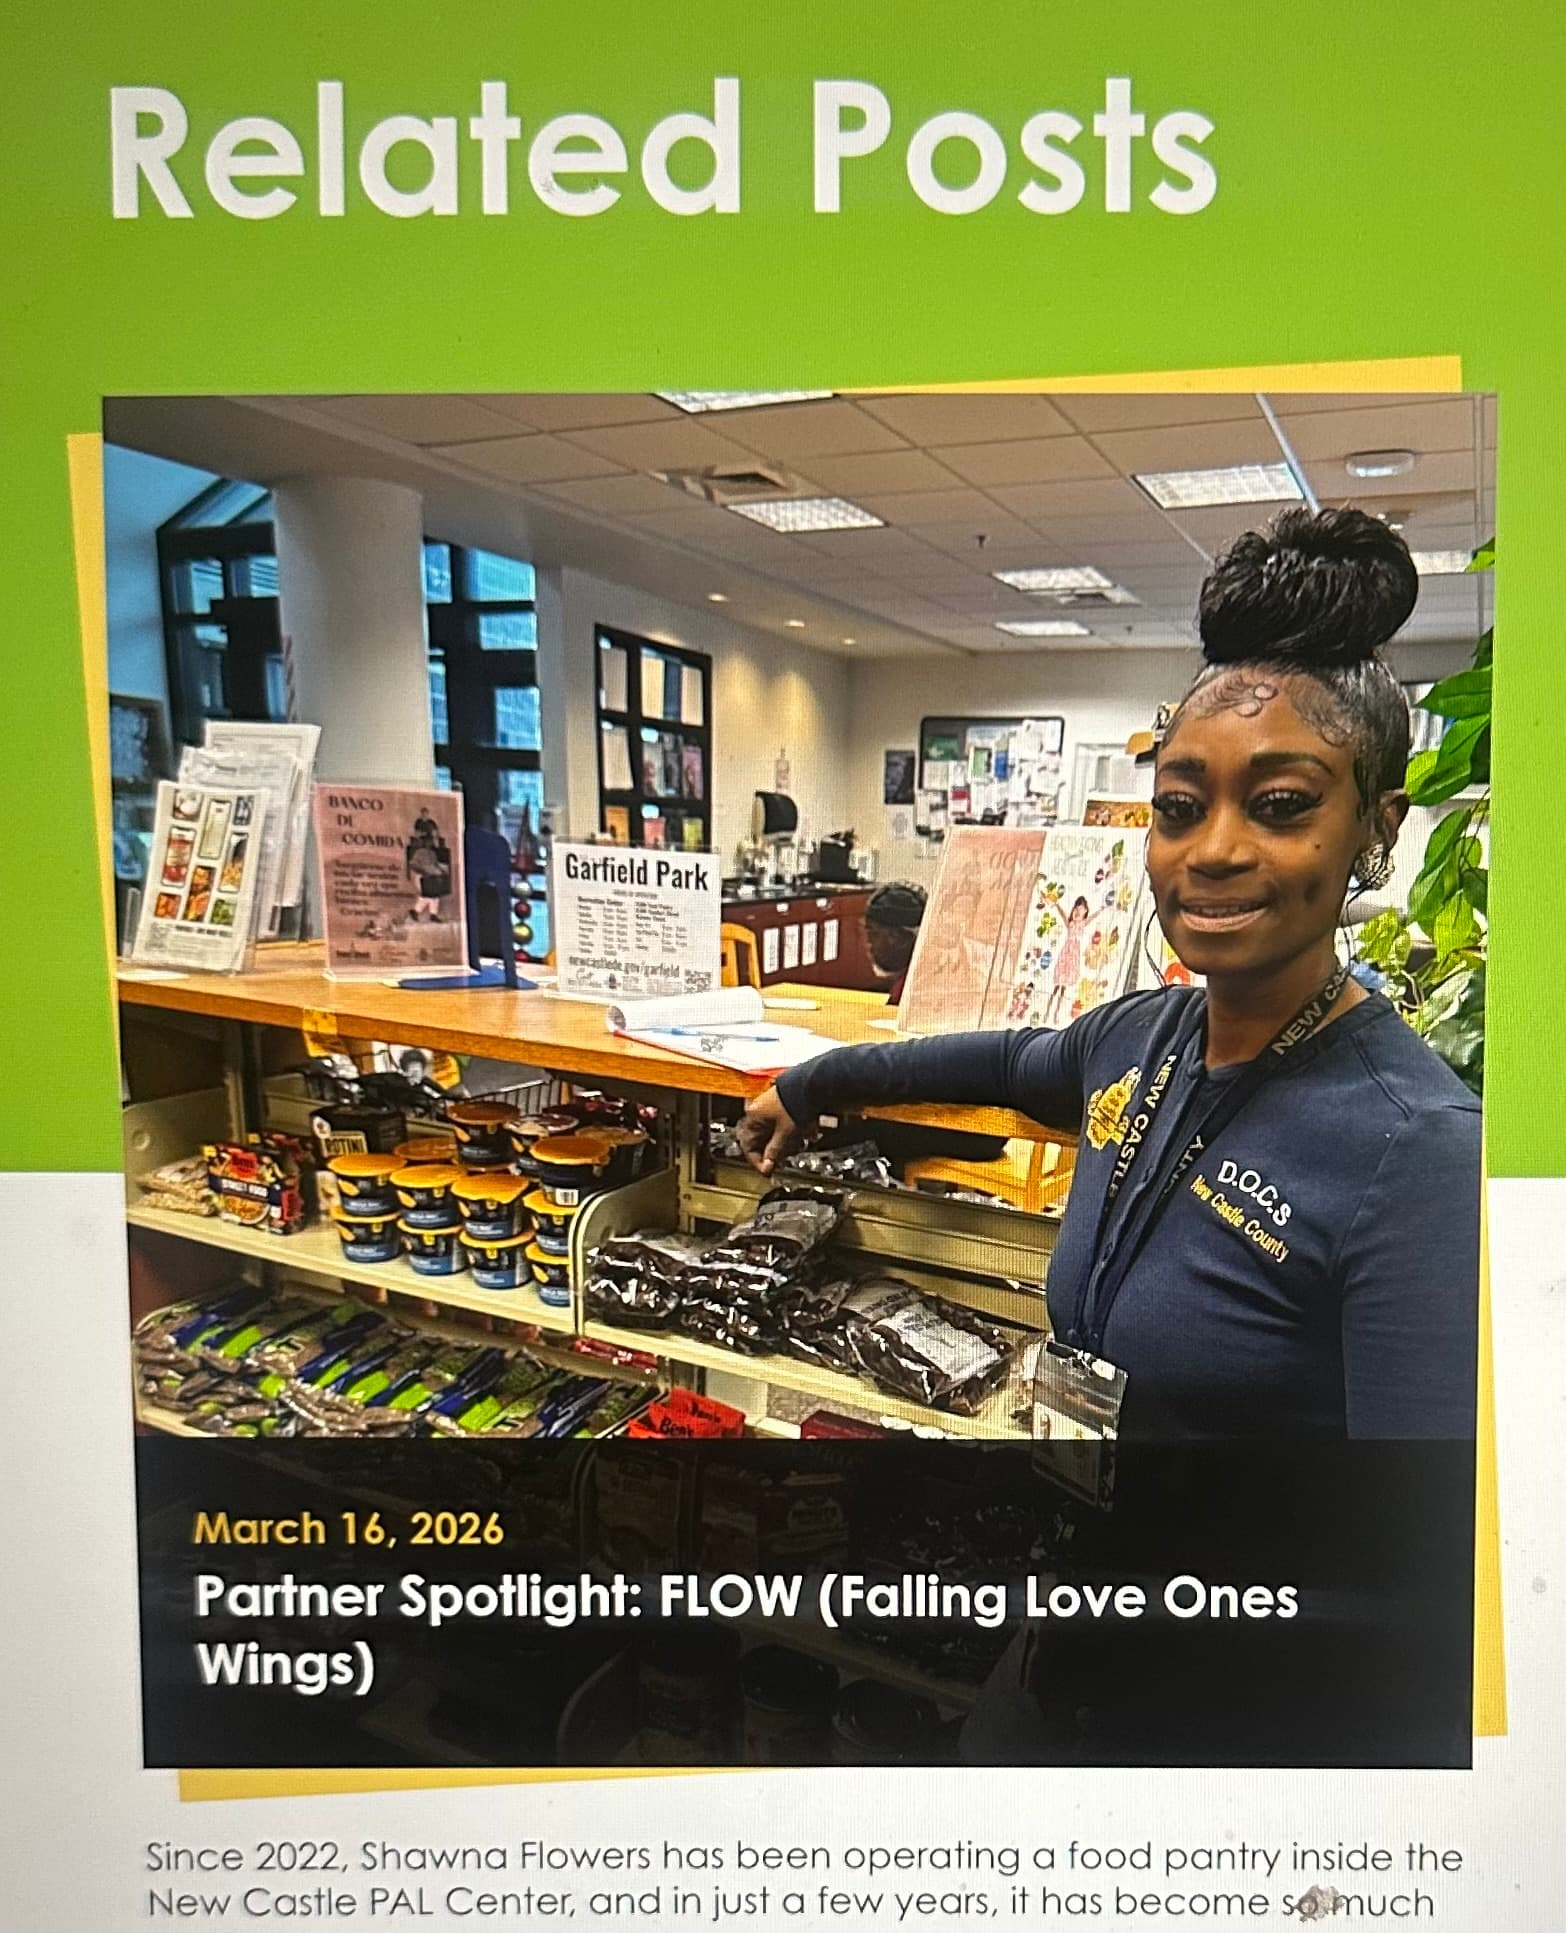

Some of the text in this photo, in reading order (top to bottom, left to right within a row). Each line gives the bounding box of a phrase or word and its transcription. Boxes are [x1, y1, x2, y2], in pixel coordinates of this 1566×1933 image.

[112, 78, 1218, 219] Related Posts
[328, 795, 383, 811] BANCO
[342, 833, 405, 849] COMIDA
[566, 853, 709, 891] Garfield Park
[1272, 1001, 1323, 1055] NEW
[325, 1138, 365, 1155] ROTINI
[1108, 1055, 1177, 1197] NEW CASTLE
[1217, 1160, 1292, 1226] D.O.C.S
[1190, 1174, 1290, 1263] New Castle County
[196, 1513, 505, 1549] March 16, 2026
[197, 1574, 1300, 1629] Partner Spotlight: FLOW (Falling Love Ones
[197, 1641, 375, 1697] Wings)
[148, 1841, 1463, 1878] Since 2022, Shawna Flowers has been operating a food pantry inside the
[150, 1887, 1435, 1923] New Castle PAL Center, and in just a few years, it has become so much
